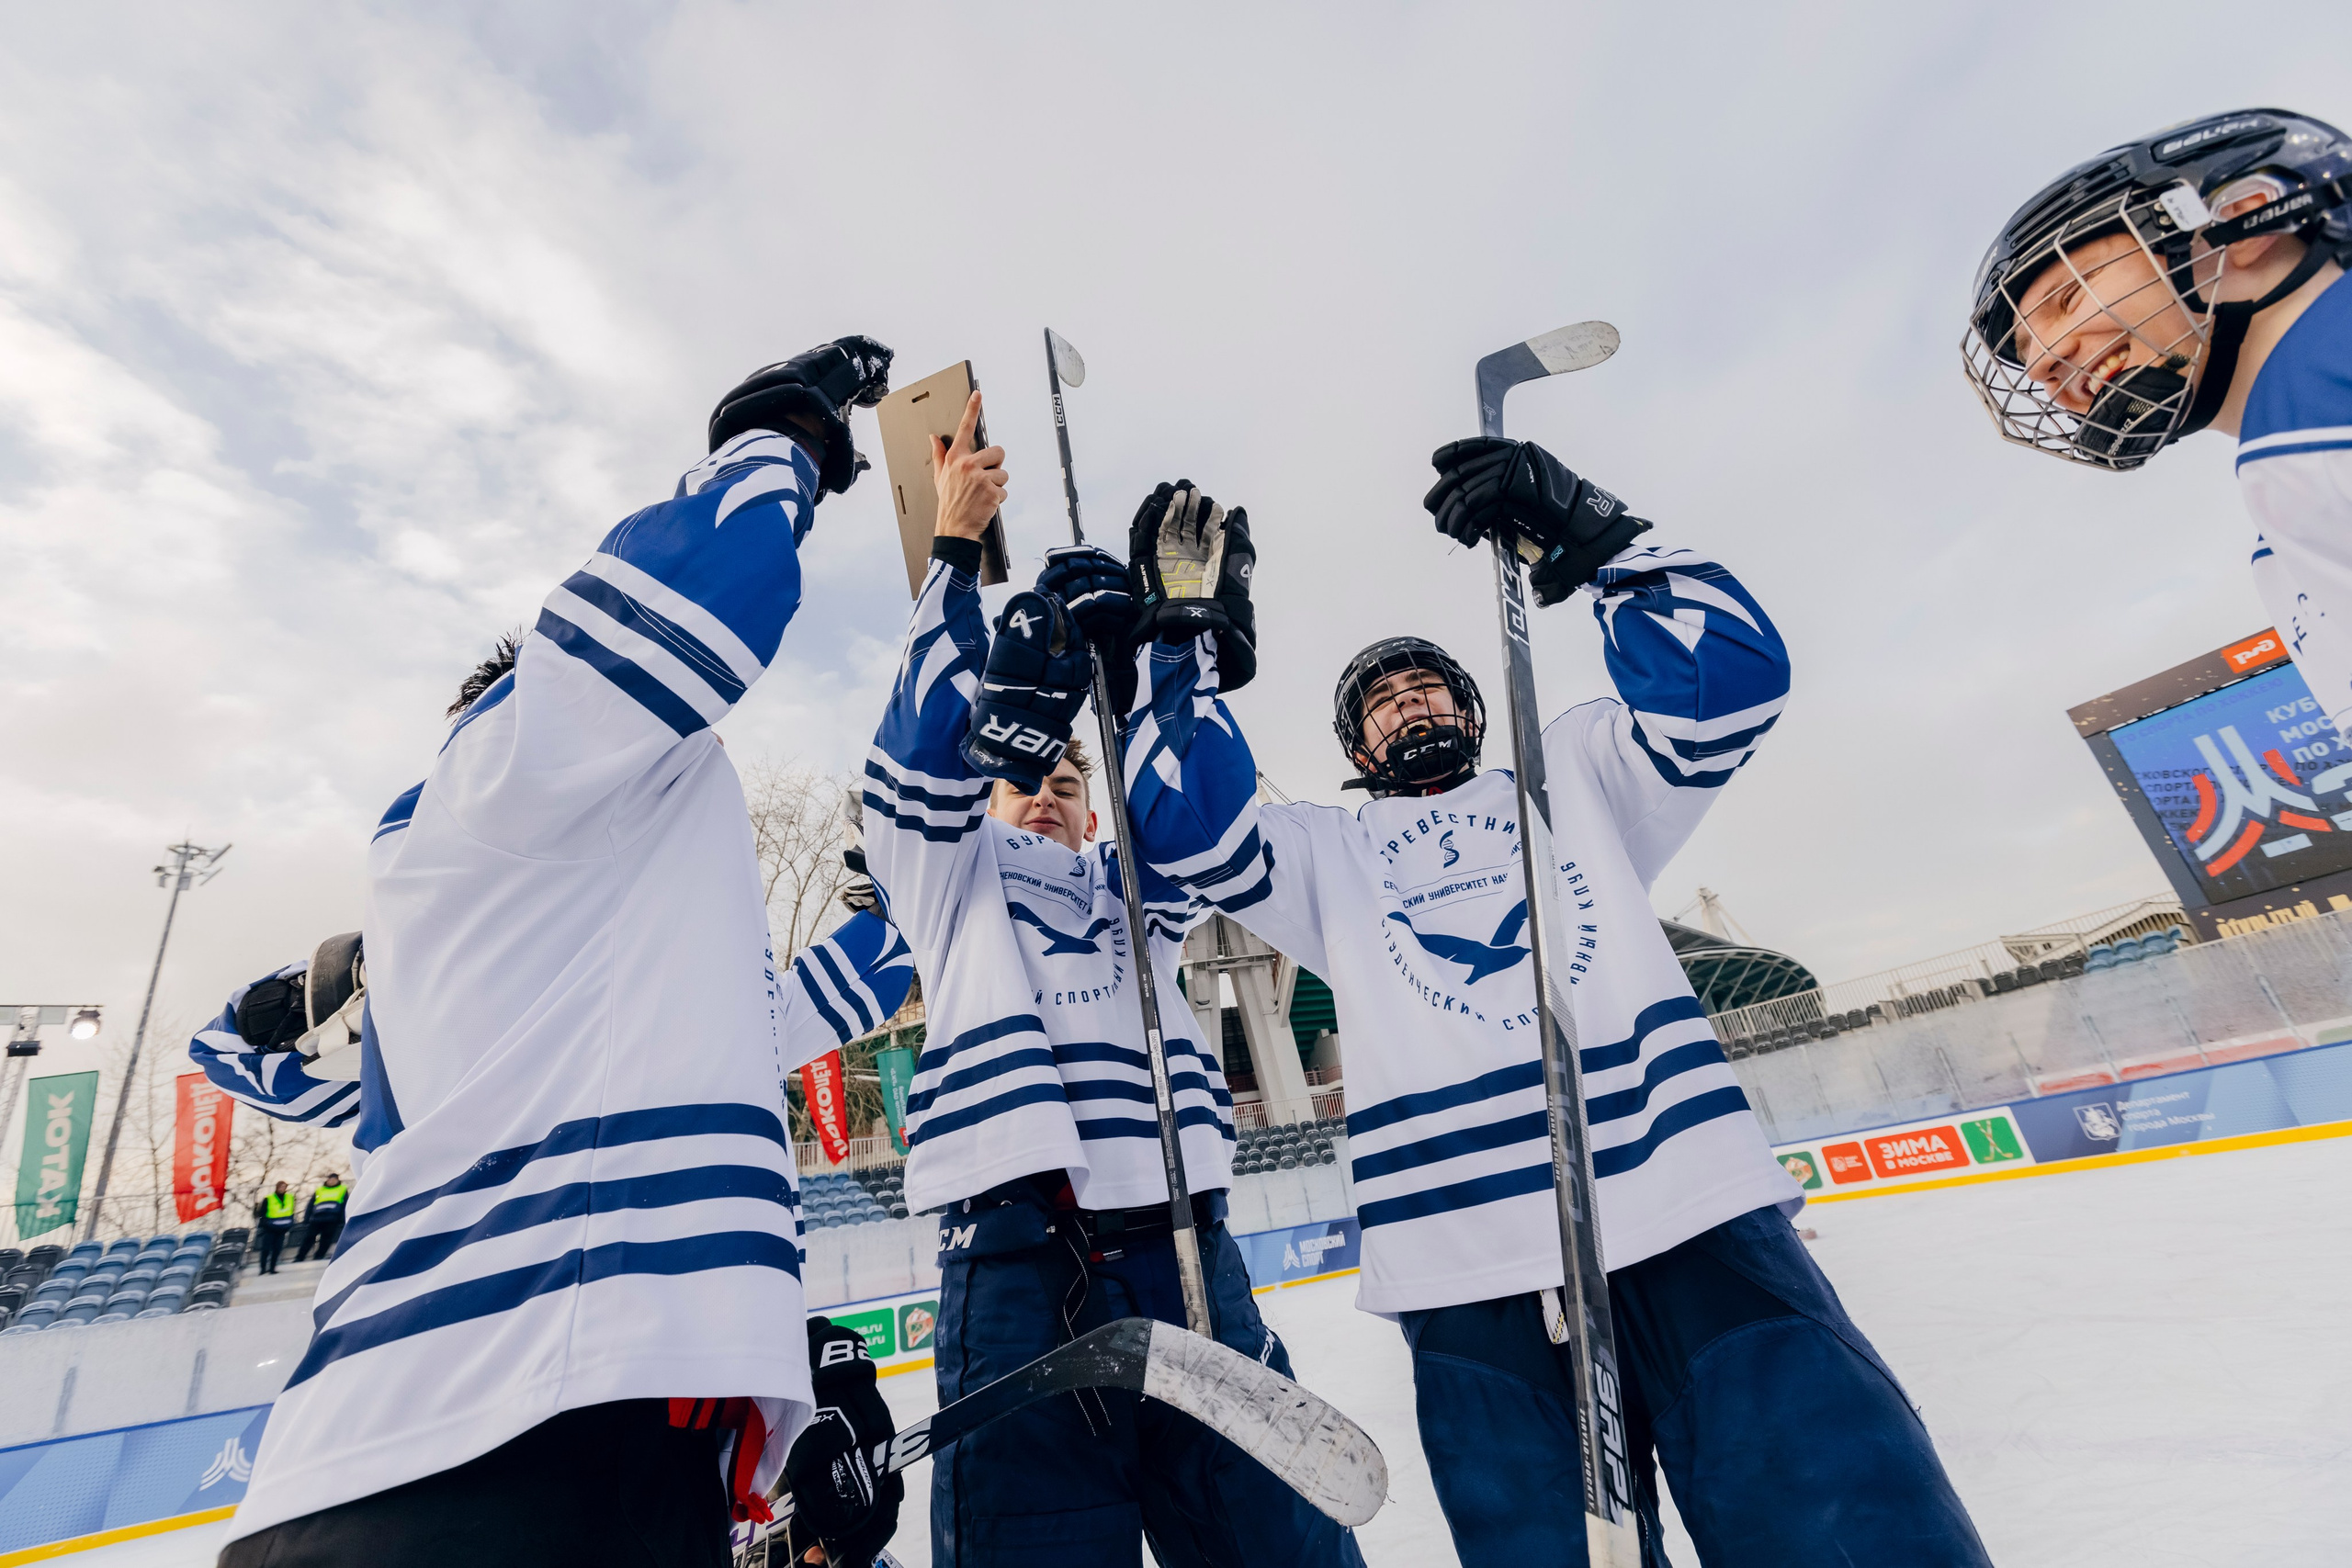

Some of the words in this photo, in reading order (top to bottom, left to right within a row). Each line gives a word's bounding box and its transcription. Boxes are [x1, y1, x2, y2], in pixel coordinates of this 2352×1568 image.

[2244, 193, 2312, 230] BAUER
[1054, 395, 1064, 424] CCM
[1403, 739, 1453, 761] CCM
[2291, 741, 2331, 762] ПО
[1044, 882, 1088, 911] УНИВЕРСИТЕТ
[1428, 877, 1488, 901] УНИВЕРСИТЕТ
[1560, 861, 1595, 910] КЛУБ
[2117, 1090, 2190, 1112] Департамент
[2120, 1108, 2162, 1122] спорта
[2127, 1118, 2167, 1133] города
[2166, 1111, 2216, 1128] Москвы
[1878, 1134, 1950, 1159] ЗИМА
[1884, 1159, 1897, 1170] В
[1897, 1150, 1955, 1169] МОСКВЕ
[937, 1223, 978, 1253] CM
[1299, 1231, 1346, 1254] МОСКОВСКИЙ
[1301, 1251, 1324, 1268] СПОРТ
